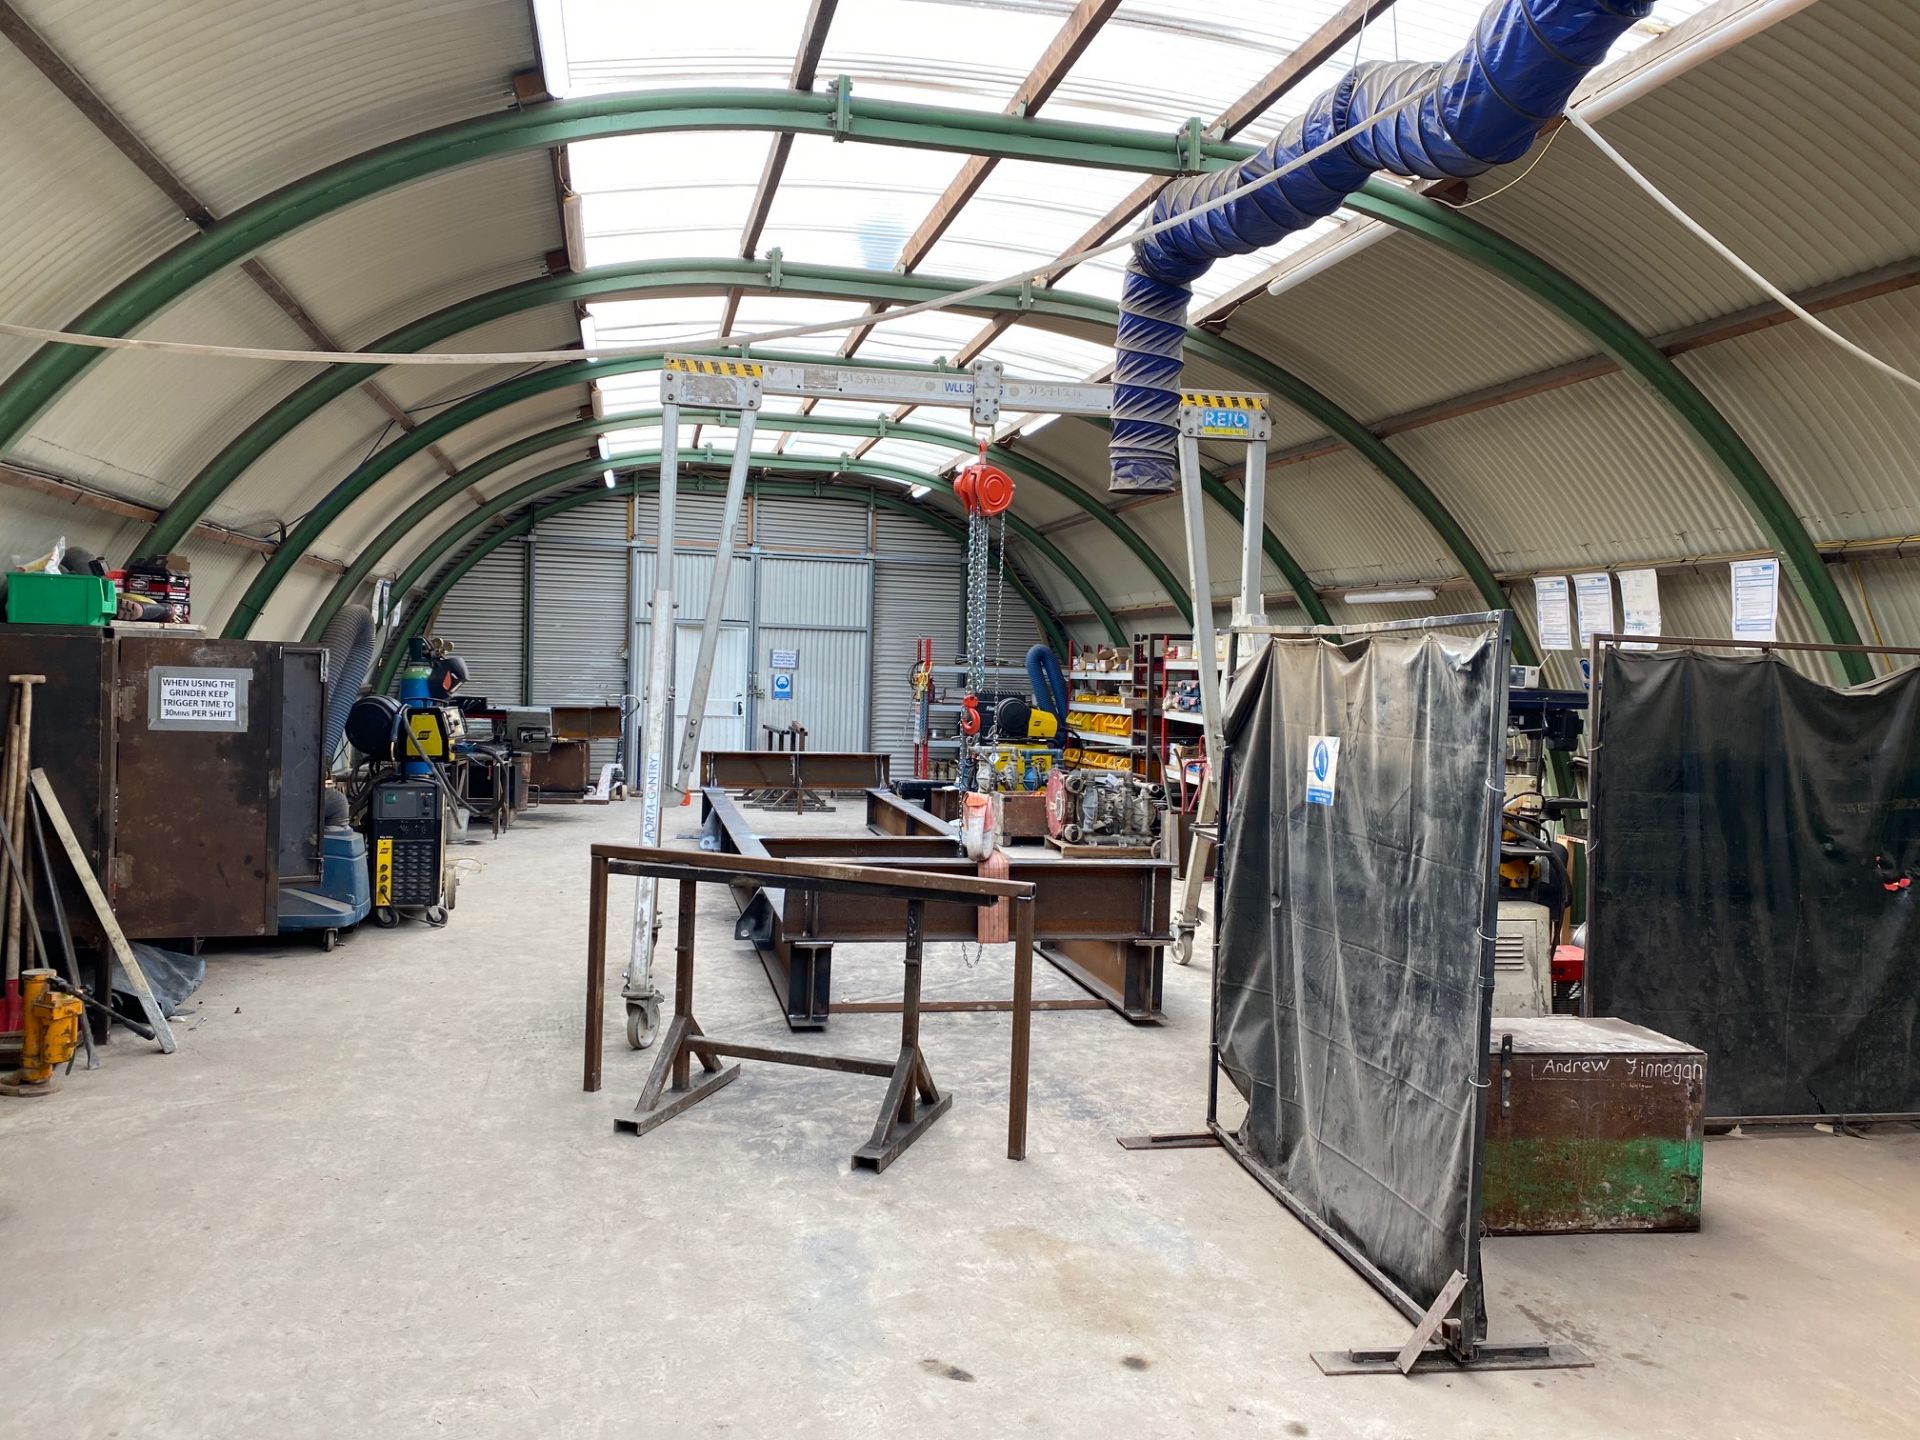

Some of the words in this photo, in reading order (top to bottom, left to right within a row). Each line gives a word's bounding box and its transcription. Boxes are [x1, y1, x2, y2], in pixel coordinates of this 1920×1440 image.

[945, 382, 964, 393] WLL
[163, 679, 189, 687] WHEN
[191, 680, 217, 688] USING
[169, 689, 206, 697] GRINDER
[208, 690, 228, 698] KEEP
[163, 699, 198, 707] TRIGGER
